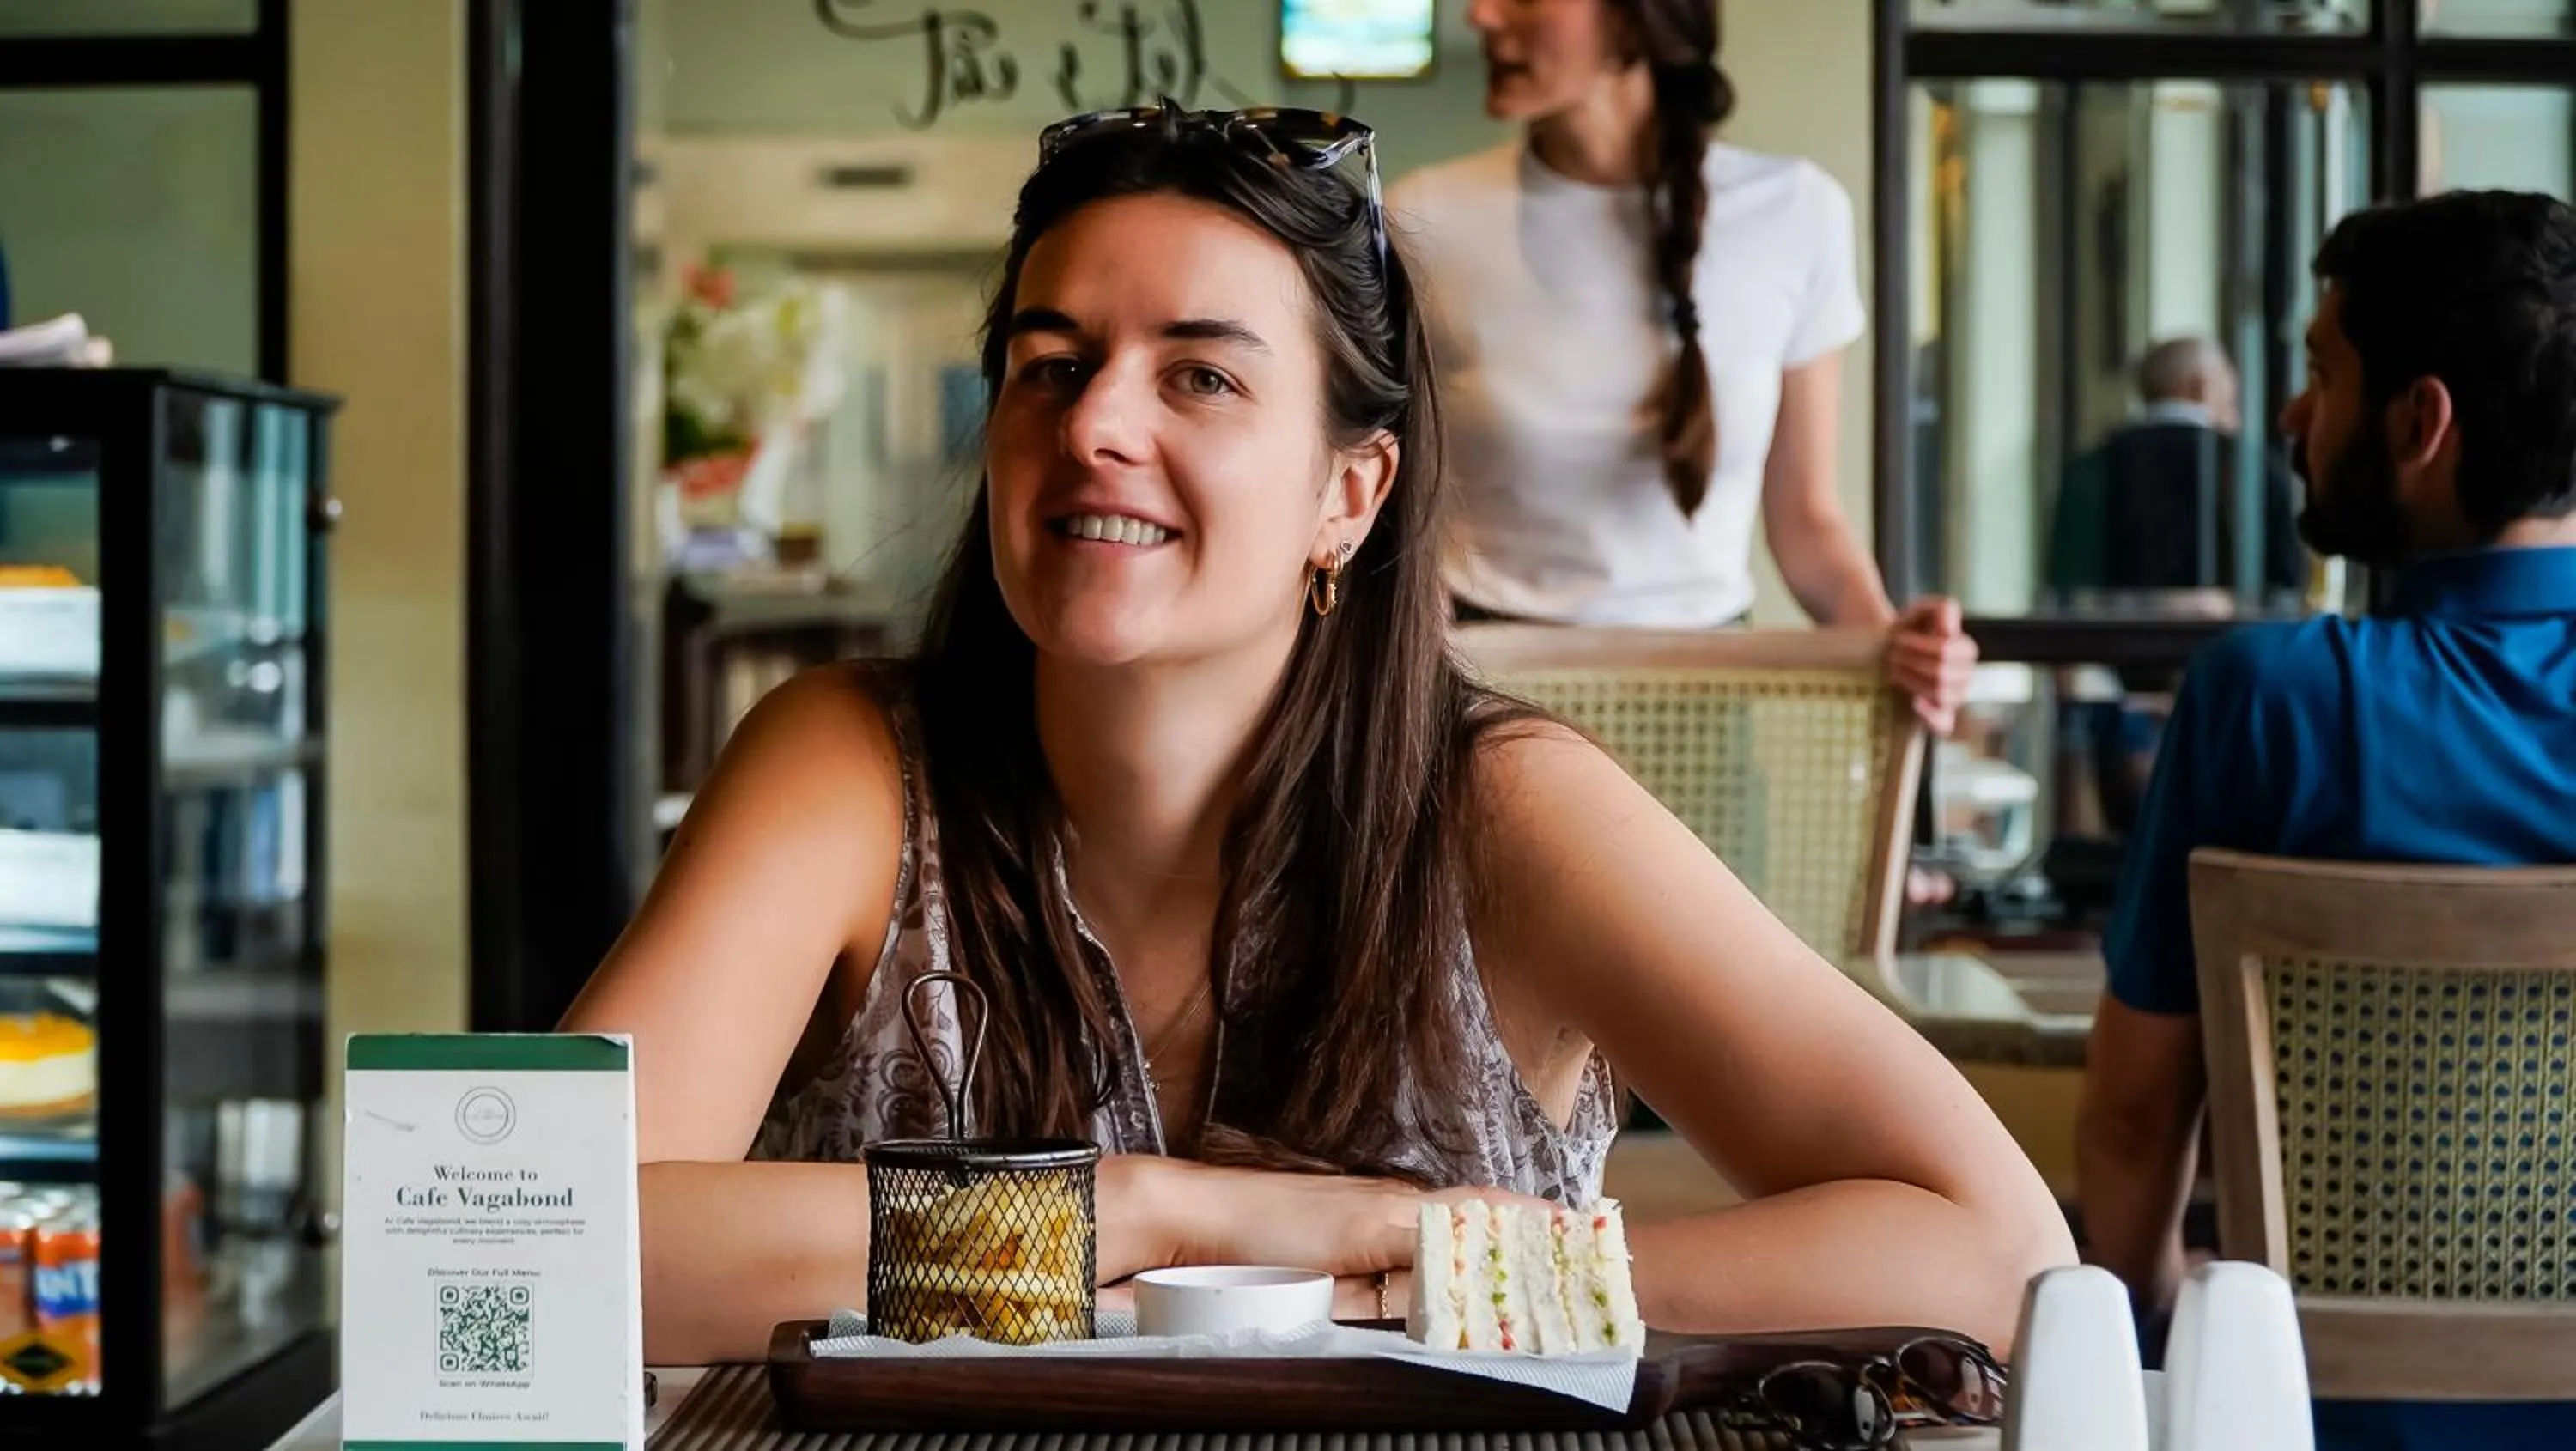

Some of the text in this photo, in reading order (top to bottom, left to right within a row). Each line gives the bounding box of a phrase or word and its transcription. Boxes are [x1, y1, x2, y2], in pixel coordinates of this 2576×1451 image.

[434, 1165, 538, 1181] Welcome to
[396, 1186, 573, 1213] Cafe Vagabond
[427, 1267, 468, 1278] Discover
[471, 1267, 489, 1277] Our
[492, 1268, 509, 1278] Full
[439, 1379, 462, 1387] Scan
[478, 1379, 531, 1389] WhatsApp
[420, 1410, 468, 1421] Delicious
[471, 1409, 511, 1421] Choices
